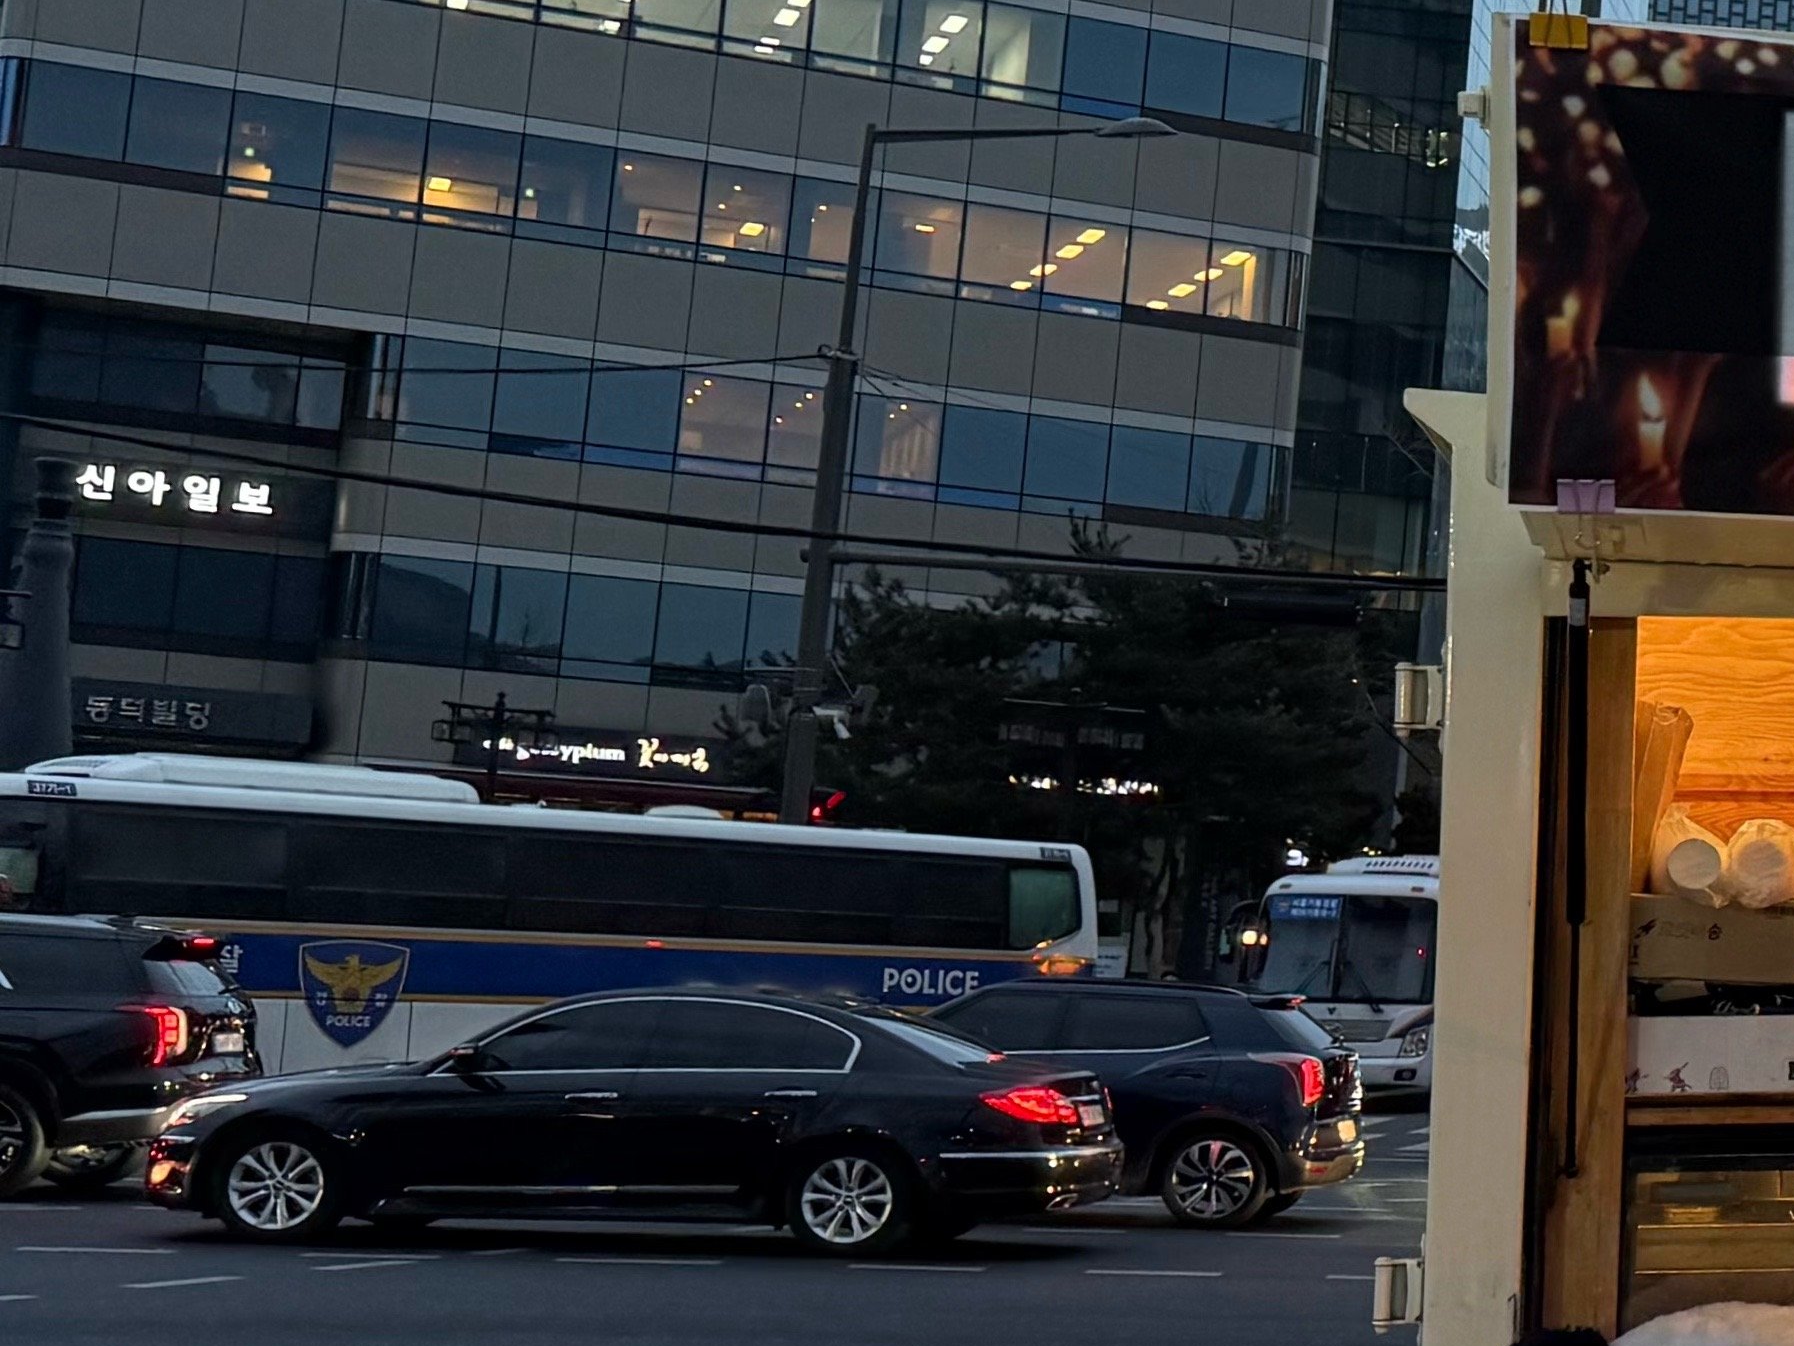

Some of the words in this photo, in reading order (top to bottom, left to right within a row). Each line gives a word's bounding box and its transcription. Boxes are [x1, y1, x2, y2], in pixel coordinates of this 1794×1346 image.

[75, 464, 273, 515] 신아일보
[86, 696, 211, 731] 동덕빌딩
[882, 967, 980, 996] POLICE
[325, 1016, 371, 1028] POLICE
